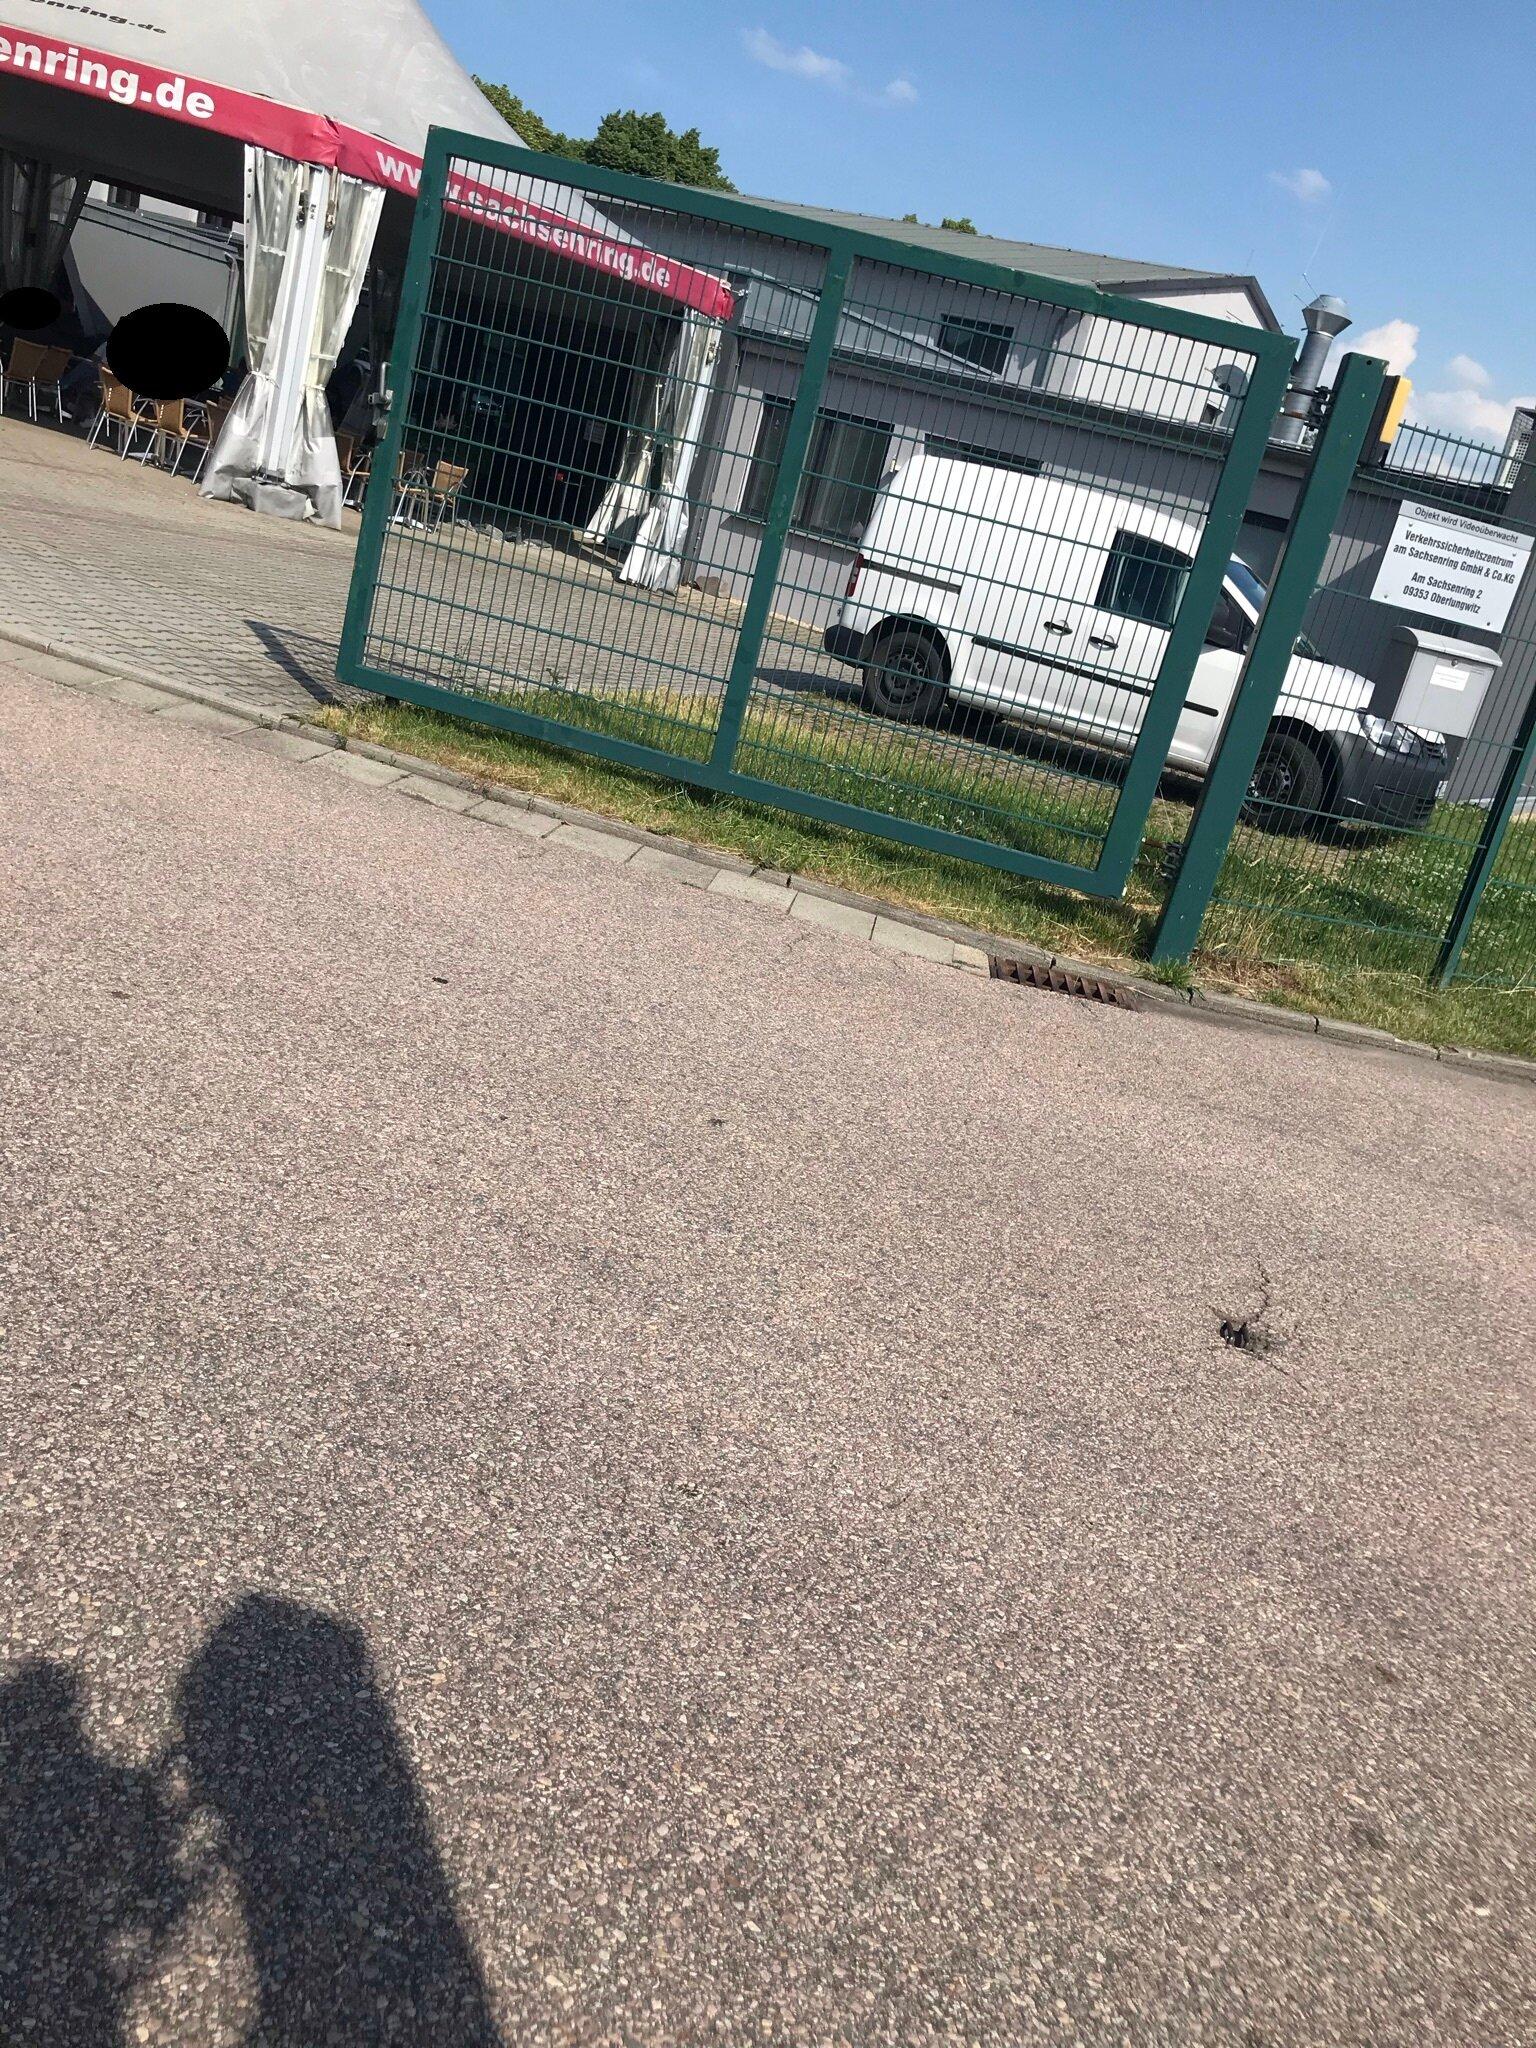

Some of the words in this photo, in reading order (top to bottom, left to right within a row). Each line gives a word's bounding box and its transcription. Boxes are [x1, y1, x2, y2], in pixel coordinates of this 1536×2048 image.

[1415, 507, 1440, 520] Objekt
[1441, 516, 1459, 526] wird
[1460, 519, 1518, 543] Videoüberwacht
[1393, 544, 1407, 554] am
[1408, 547, 1459, 570] Sachsenring
[1460, 561, 1483, 575] GmbH
[1484, 568, 1490, 577] &
[1492, 570, 1515, 584] Co.KG
[1405, 530, 1514, 568] Verkehrssicherheitszentrum
[1403, 585, 1429, 600] 09353
[1431, 593, 1481, 614] Oberlungwitz
[1411, 572, 1425, 583] Am
[1427, 576, 1475, 598] Sachsenring
[1476, 590, 1483, 599] 2
